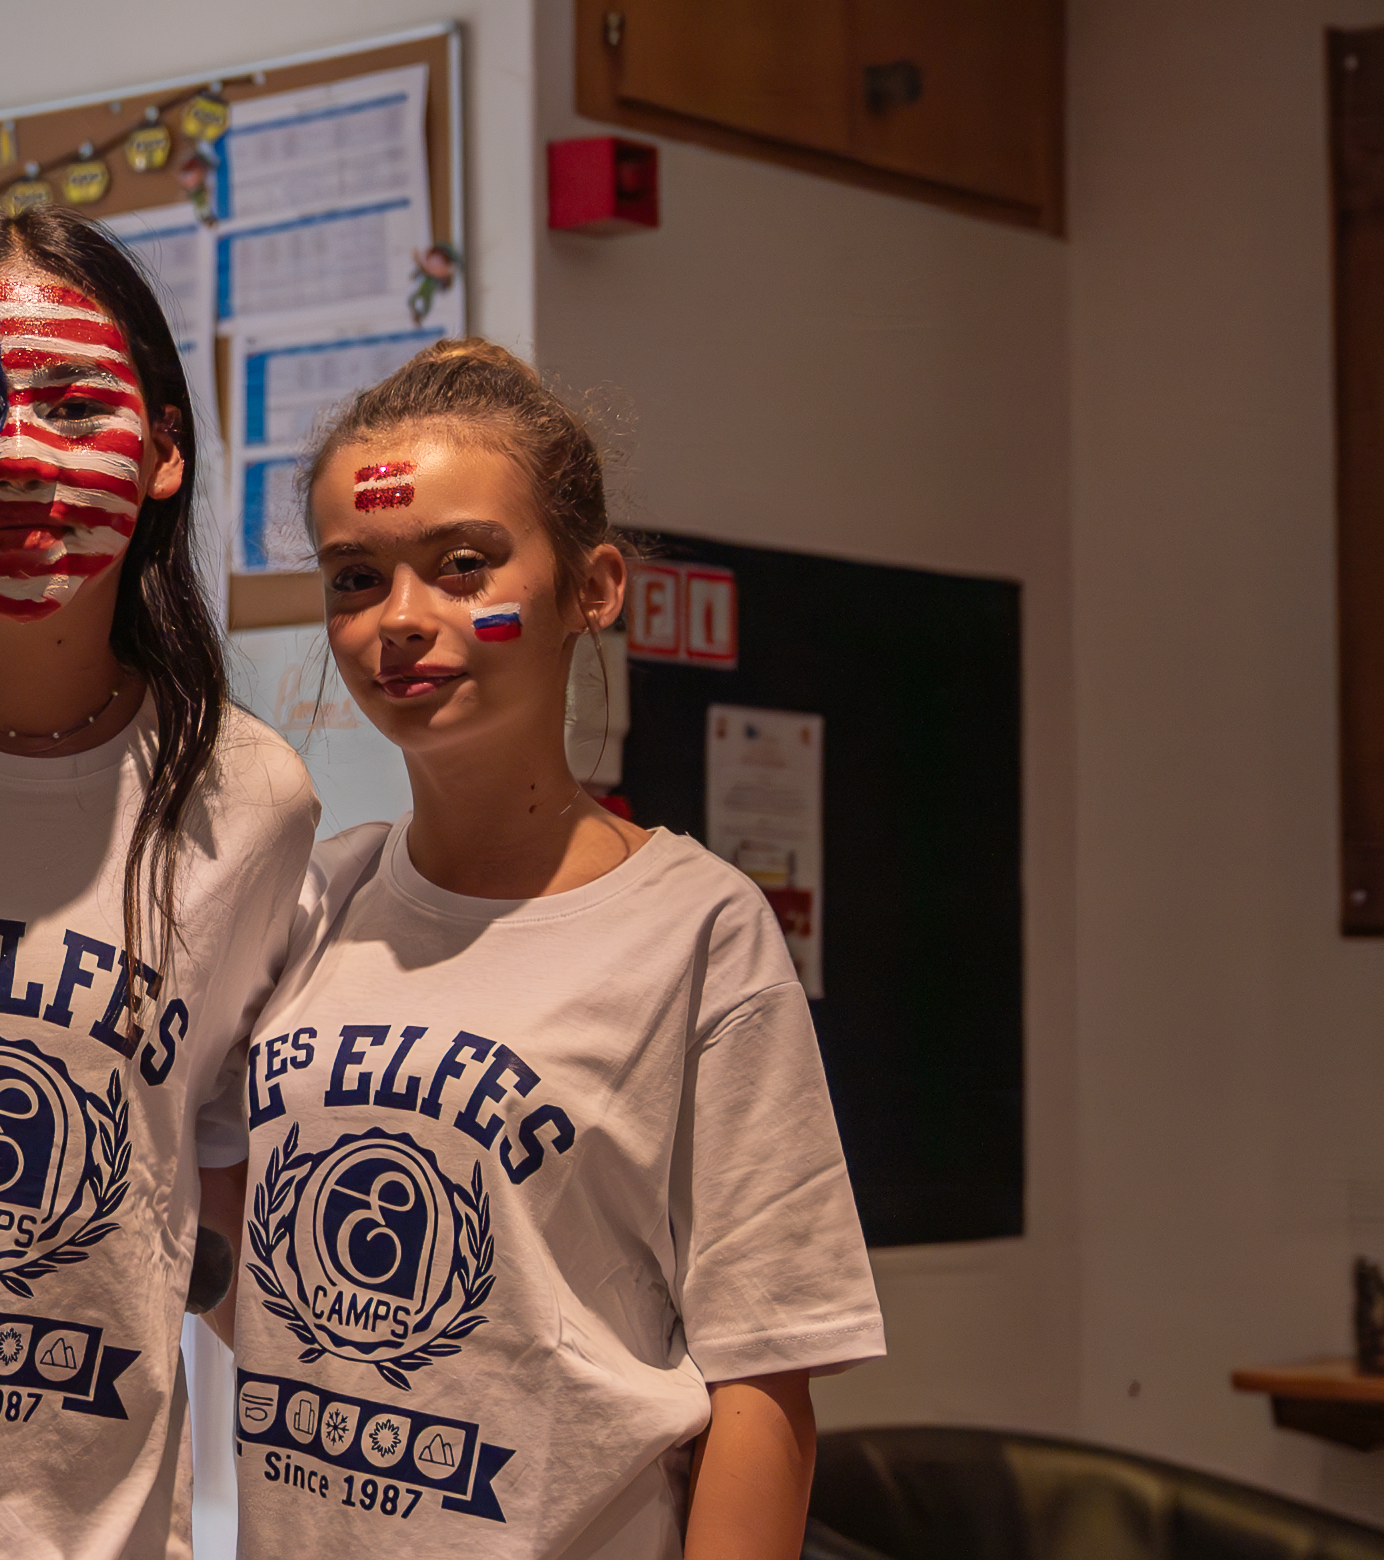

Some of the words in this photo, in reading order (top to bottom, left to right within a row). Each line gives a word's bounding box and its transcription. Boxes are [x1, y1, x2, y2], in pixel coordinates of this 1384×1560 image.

[324, 1024, 575, 1185] ELFES
[312, 1284, 412, 1339] CAMPS
[264, 1451, 329, 1499] Since
[342, 1475, 423, 1520] 1987
